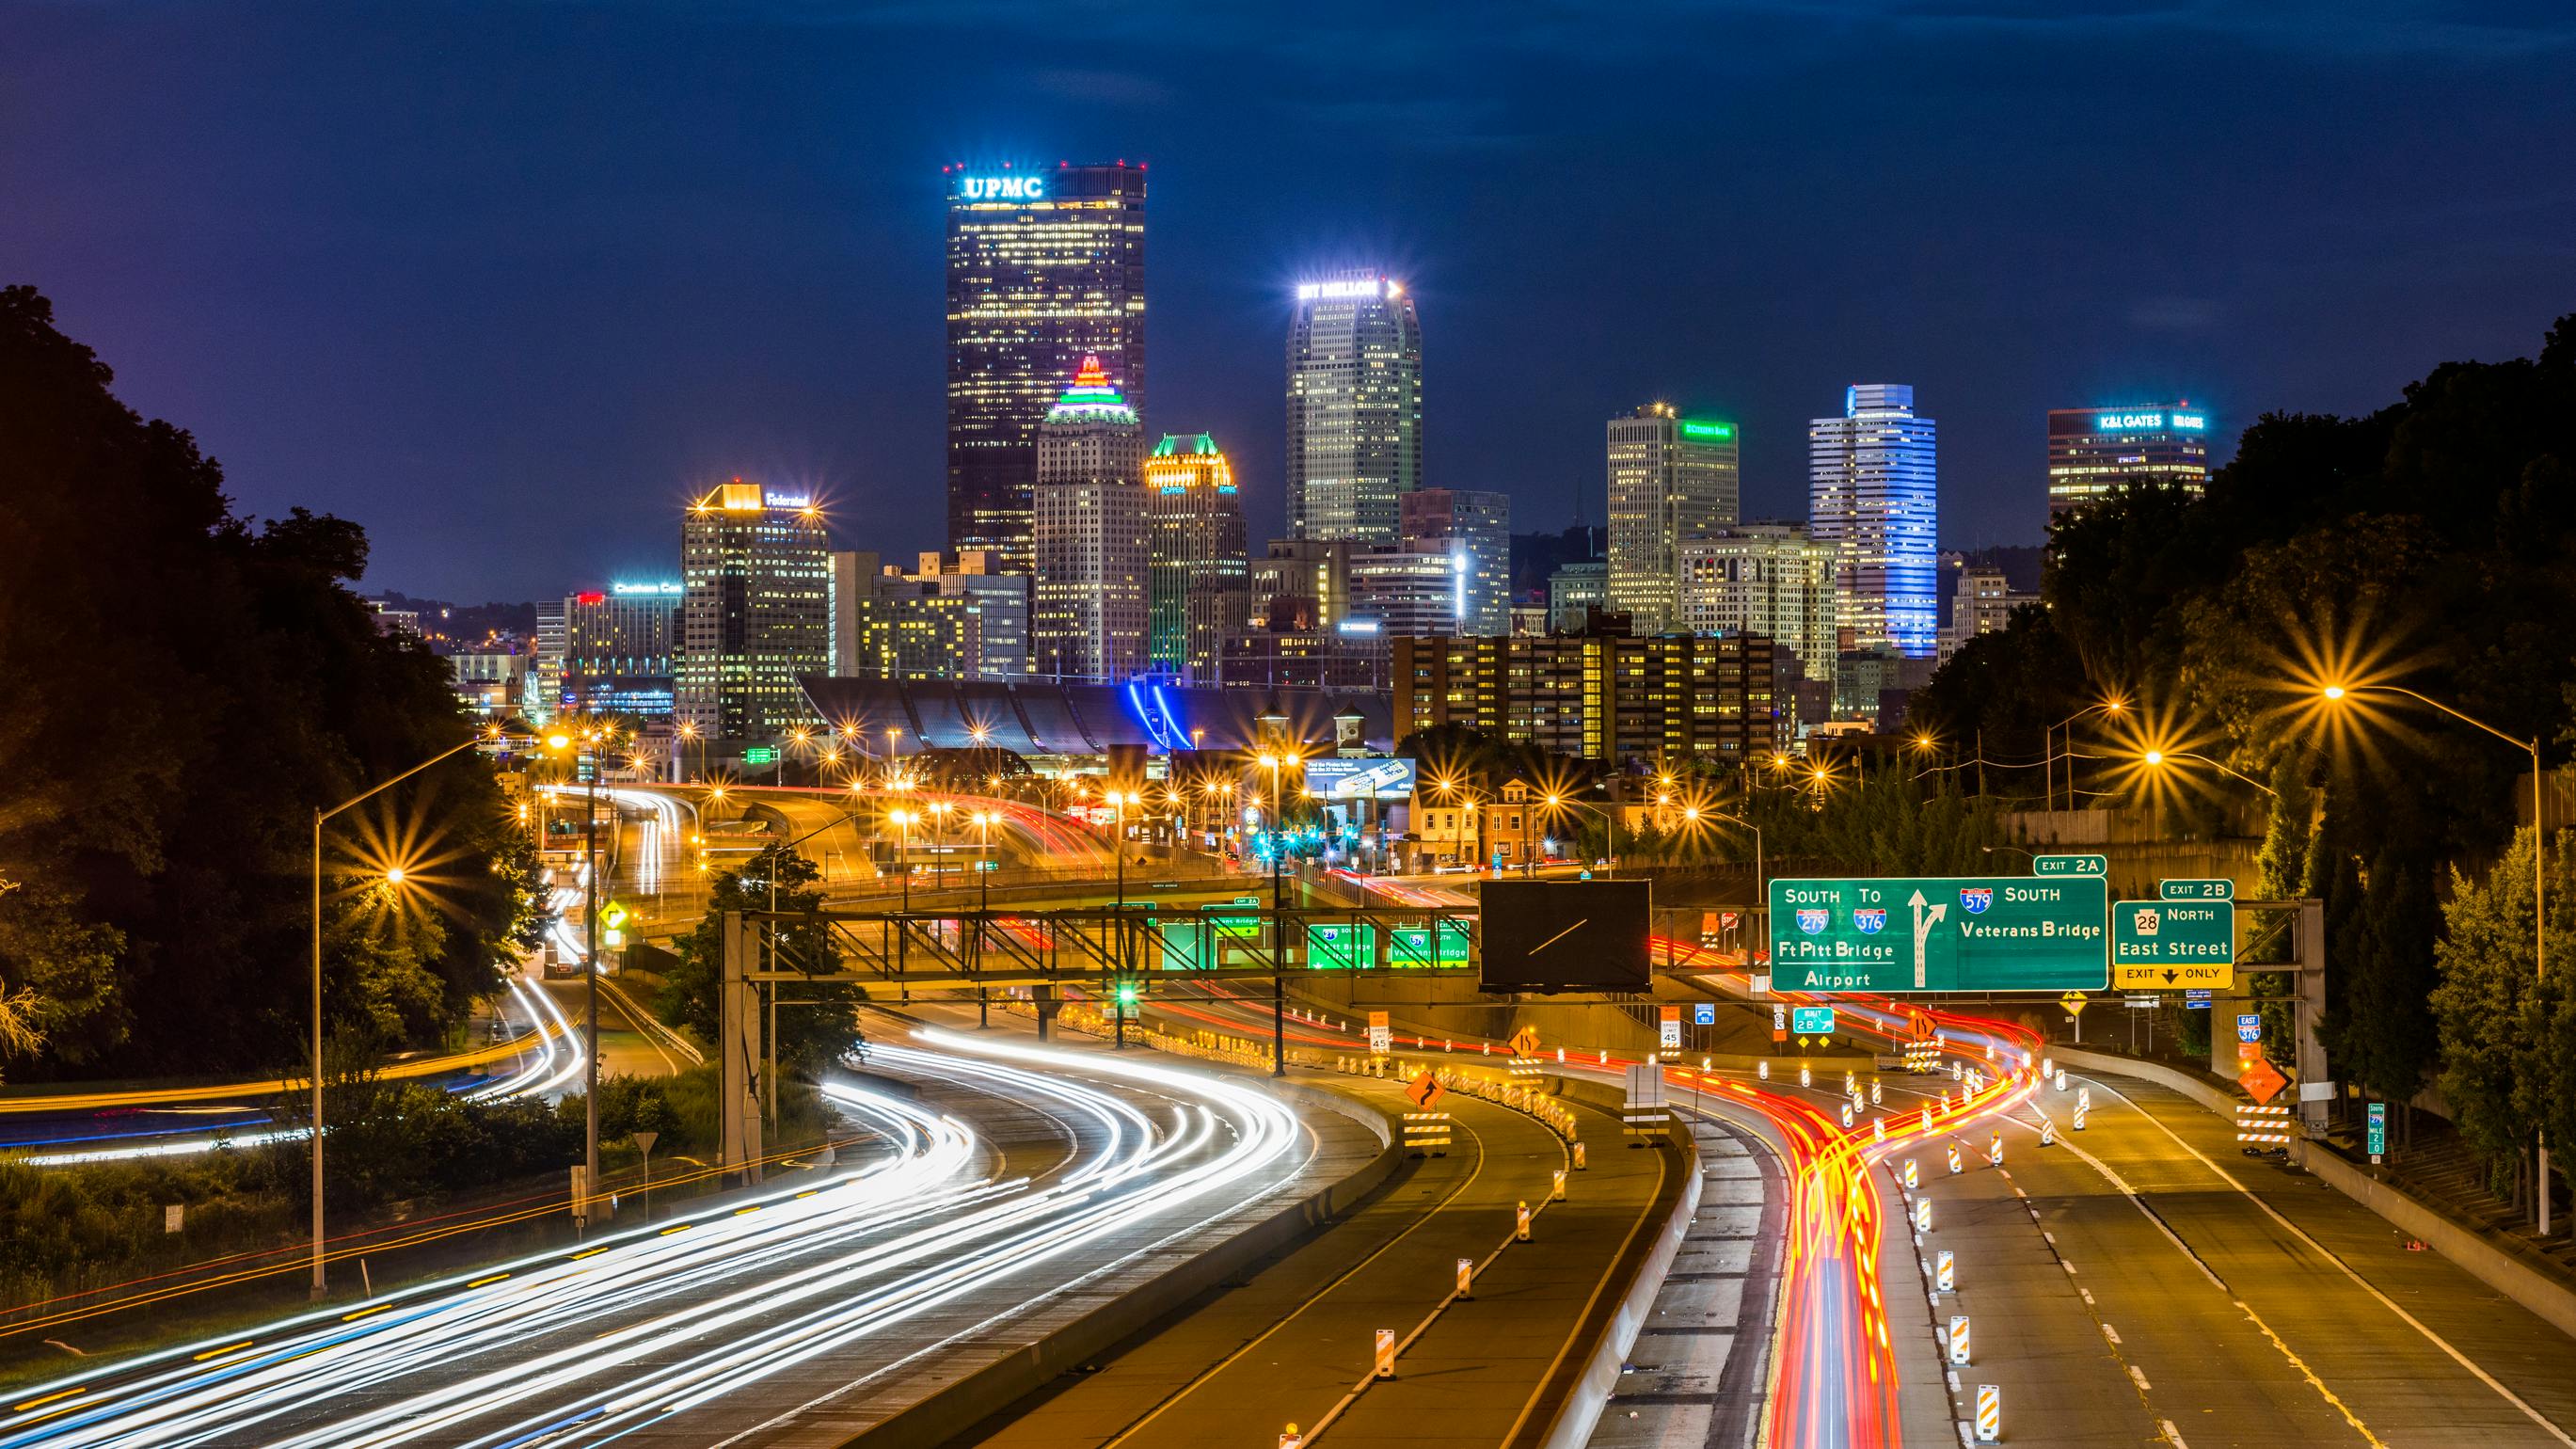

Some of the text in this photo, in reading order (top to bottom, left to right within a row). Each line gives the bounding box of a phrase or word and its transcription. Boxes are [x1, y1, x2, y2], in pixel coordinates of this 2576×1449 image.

[965, 178, 1042, 197] UPMC
[2100, 415, 2162, 428] K&L GATES
[766, 493, 808, 506] Federated
[2076, 860, 2098, 871] 2A
[1785, 888, 1881, 903] SOUTH TO
[2005, 887, 2060, 901] SOUTH
[2170, 884, 2225, 896] EXIT 2B
[1965, 895, 1991, 909] 579
[2168, 908, 2214, 920] NORTH
[1802, 916, 1825, 930] 279
[1858, 916, 1883, 930] 376
[2138, 916, 2157, 930] 28
[1960, 921, 2100, 940] Veterans Bridge
[1779, 941, 1893, 961] Ft Pitt Bridge
[2120, 942, 2228, 956] East Street
[1805, 971, 1870, 988] Airport
[2126, 969, 2219, 978] EXIT ONLY
[2241, 1029, 2258, 1040] 376
[1373, 1039, 1386, 1047] 45
[2374, 1134, 2379, 1142] 2
